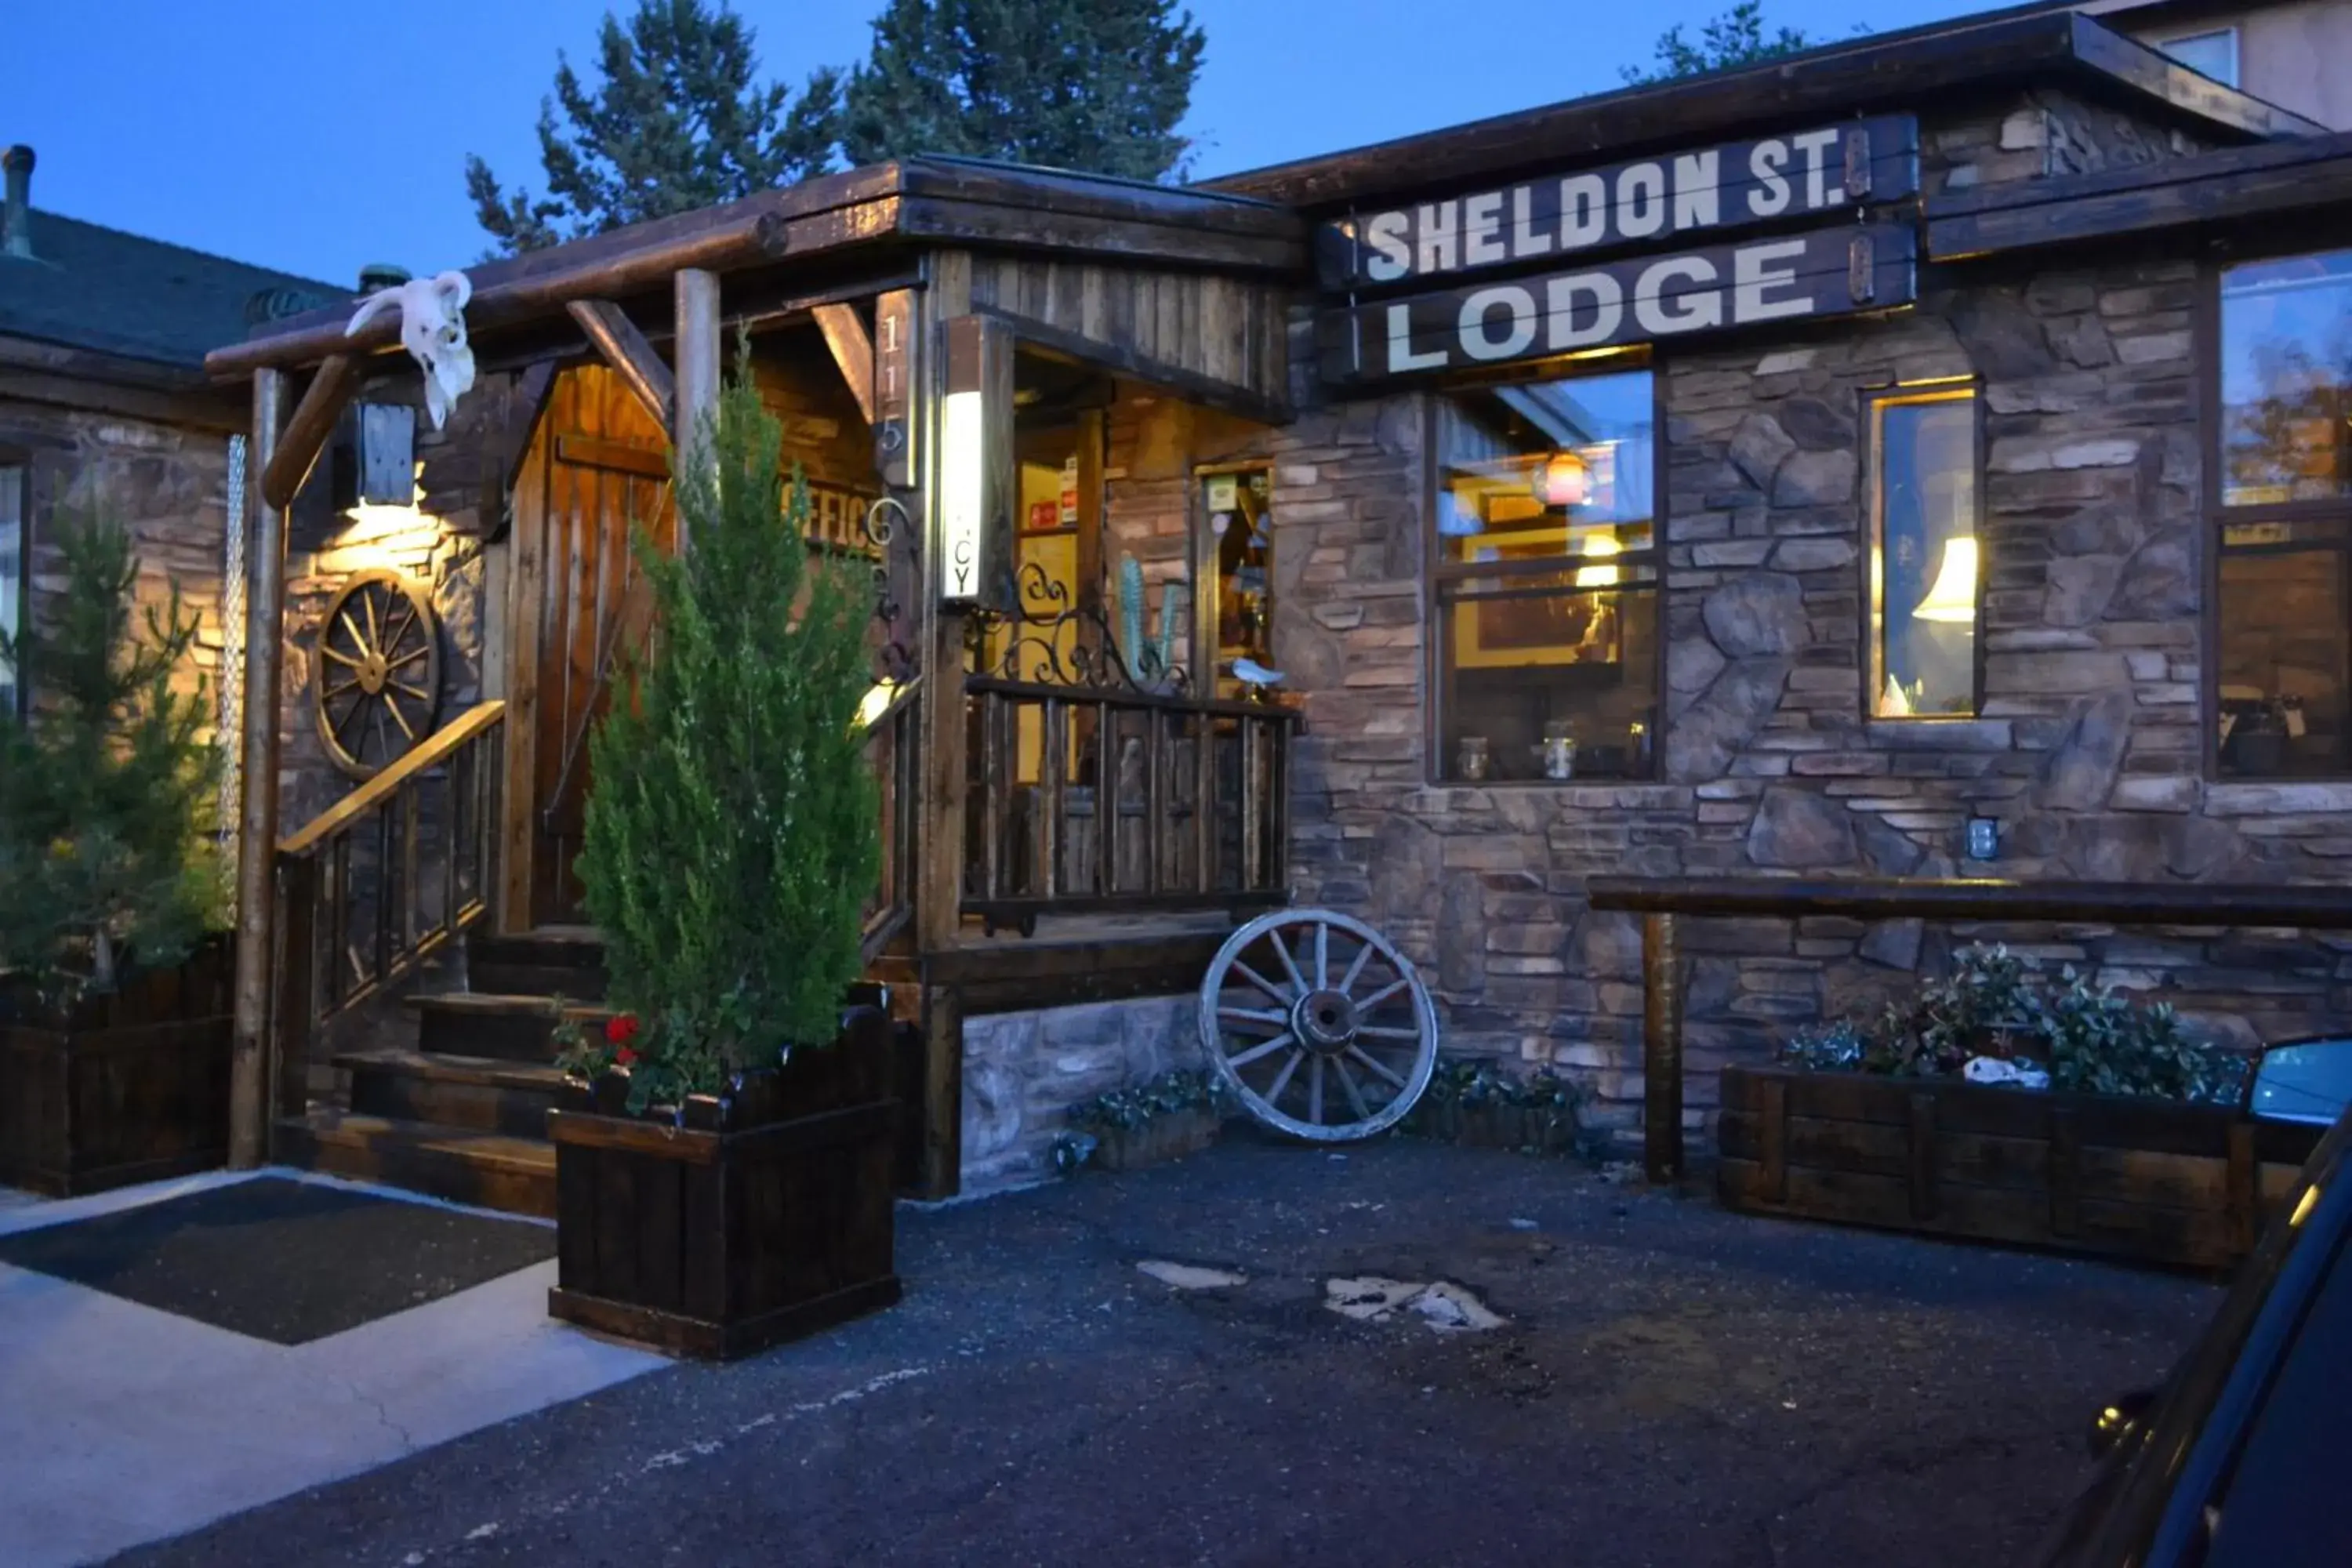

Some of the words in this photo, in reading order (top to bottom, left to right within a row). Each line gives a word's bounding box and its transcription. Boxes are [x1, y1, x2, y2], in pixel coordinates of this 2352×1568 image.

[1367, 150, 1720, 281] SHELDON
[1748, 128, 1845, 217] ST.
[1387, 239, 1813, 373] LODGE
[882, 315, 902, 450] 115
